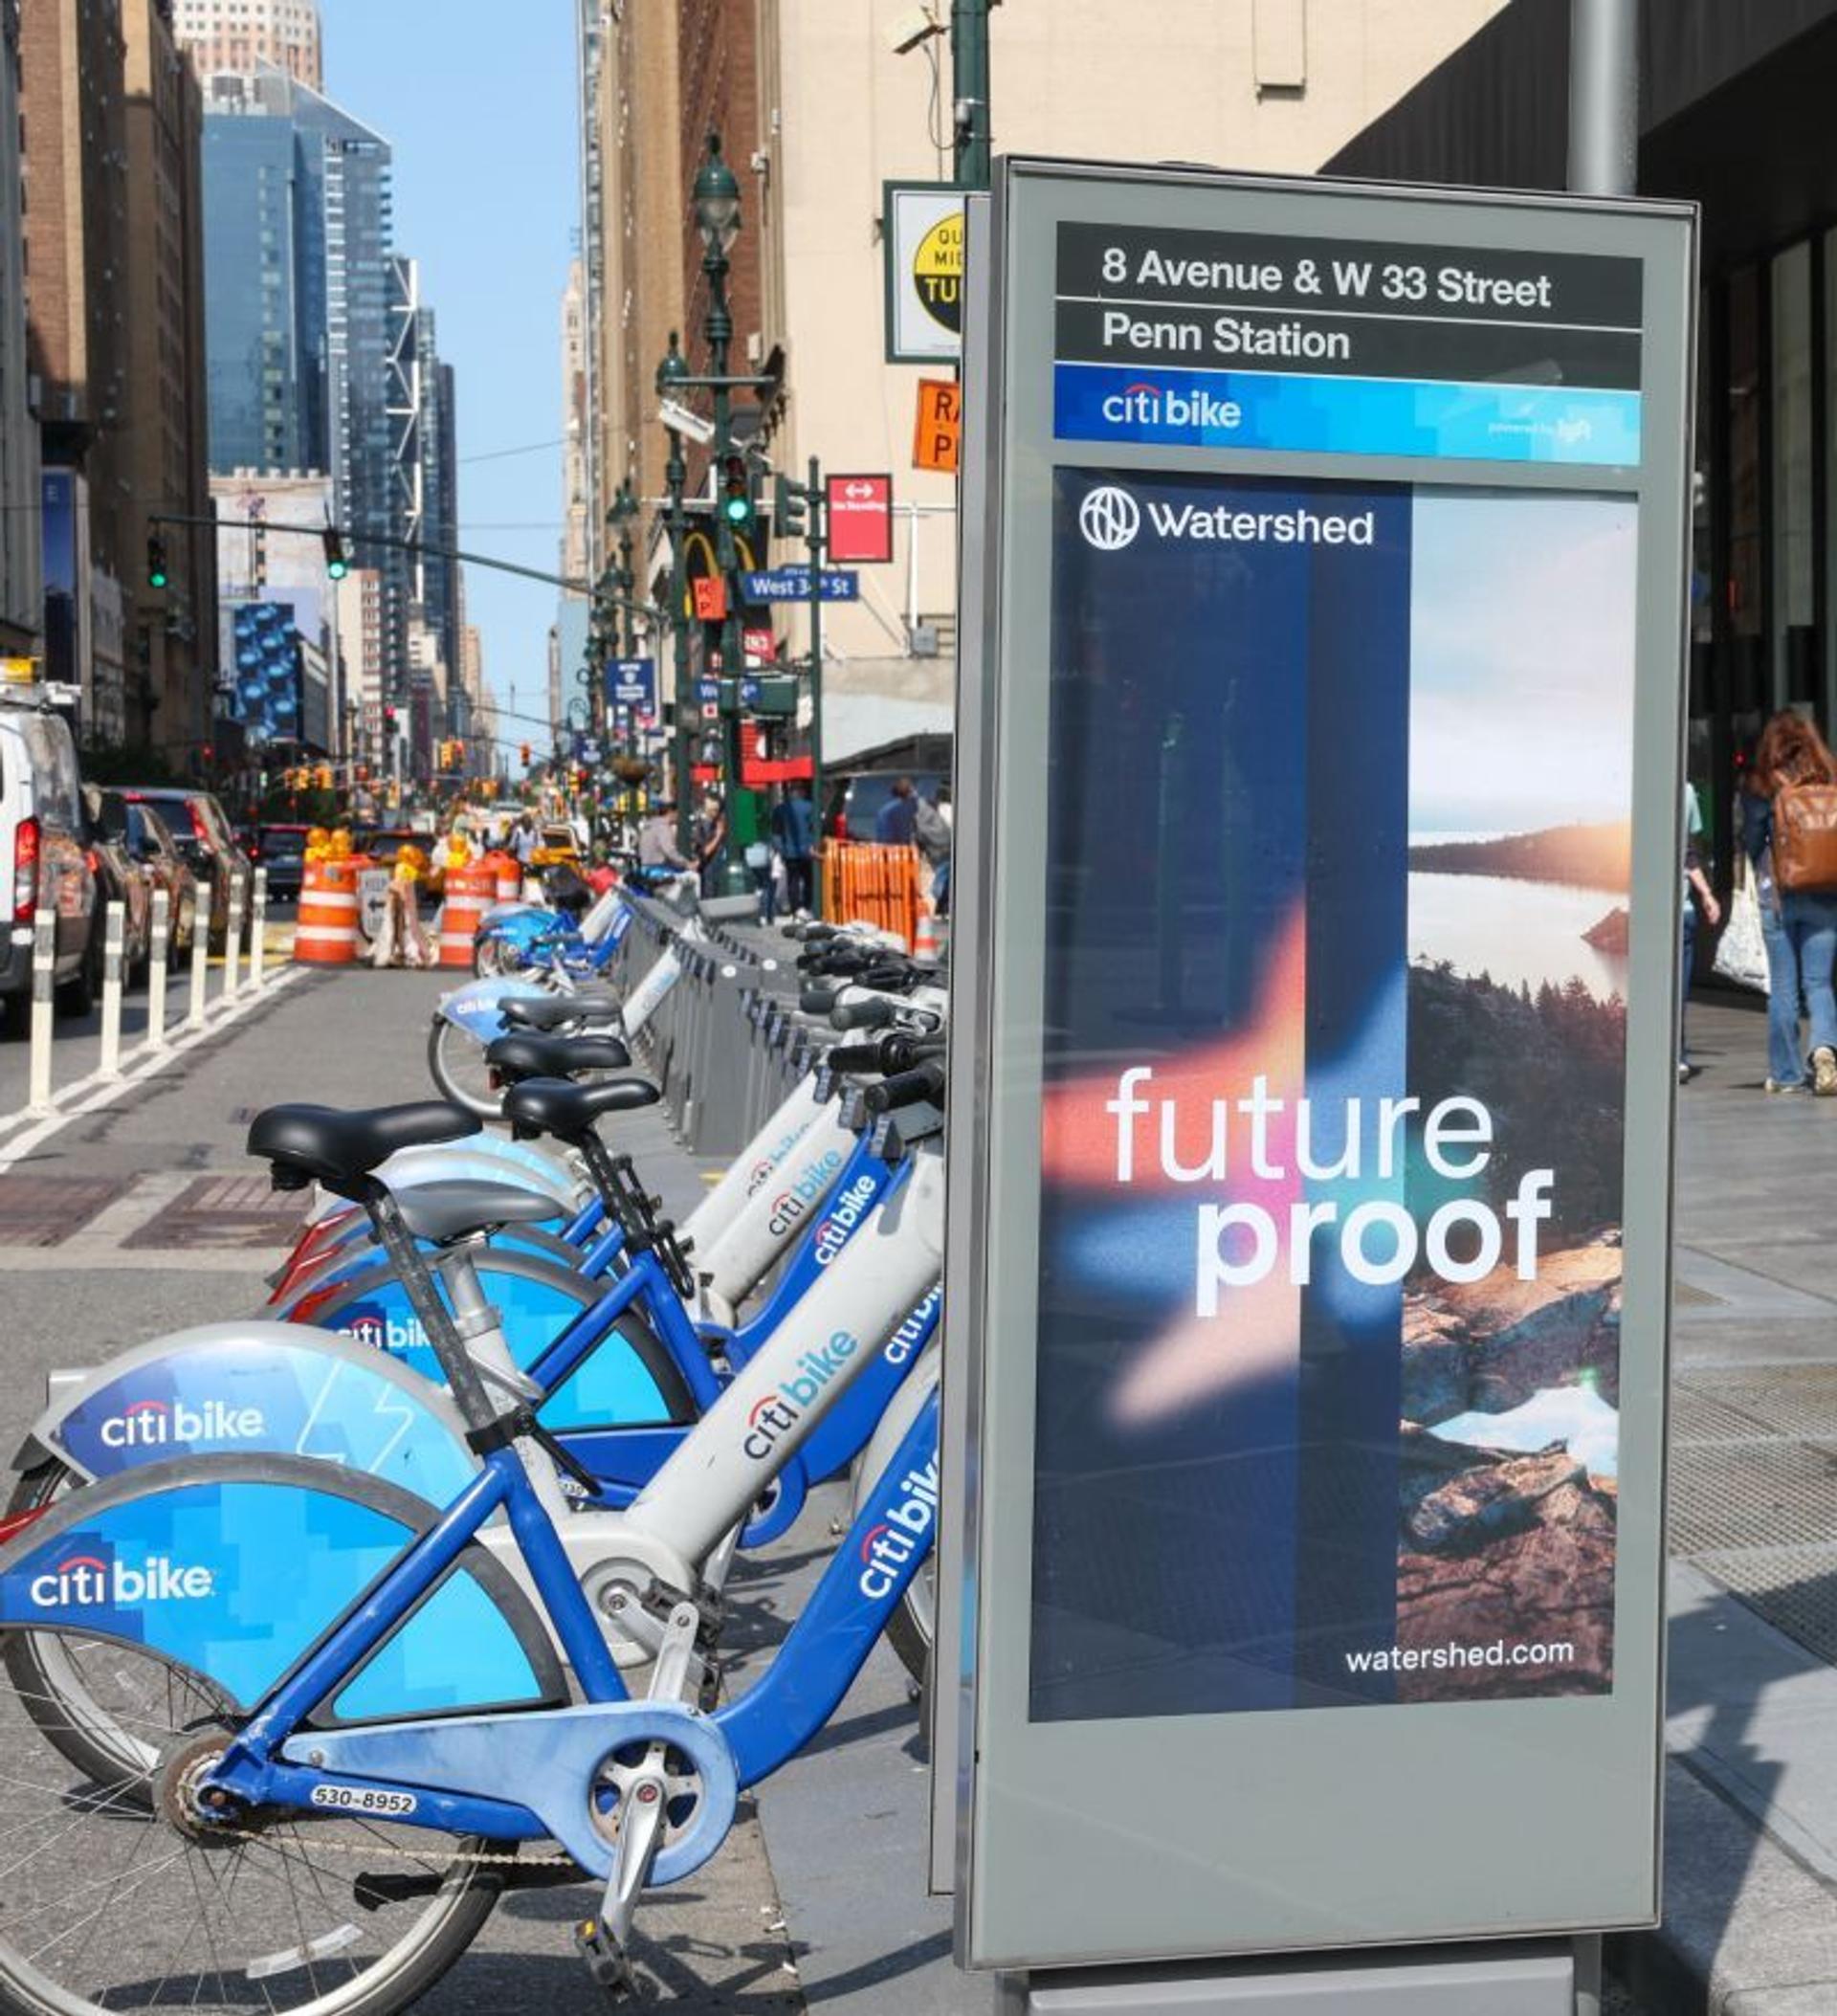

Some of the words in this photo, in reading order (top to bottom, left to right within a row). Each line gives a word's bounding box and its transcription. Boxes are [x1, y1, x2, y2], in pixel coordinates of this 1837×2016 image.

[924, 277, 958, 302] TU
[1102, 247, 1126, 283] 8
[1136, 250, 1283, 293] Avenue
[1294, 259, 1322, 295] &
[1332, 261, 1373, 297] W
[1381, 264, 1428, 300] 33
[1437, 267, 1552, 308] Street
[1102, 311, 1203, 351] Penn
[1212, 317, 1350, 361] Station
[1147, 502, 1374, 545] Watershed
[752, 578, 794, 595] West
[830, 578, 850, 594] St
[1107, 1067, 1494, 1182] future
[1196, 1169, 1554, 1318] proof
[886, 1449, 939, 1535] bik
[1345, 1639, 1575, 1673] watershed.com
[314, 1787, 412, 1812] 530-8952
